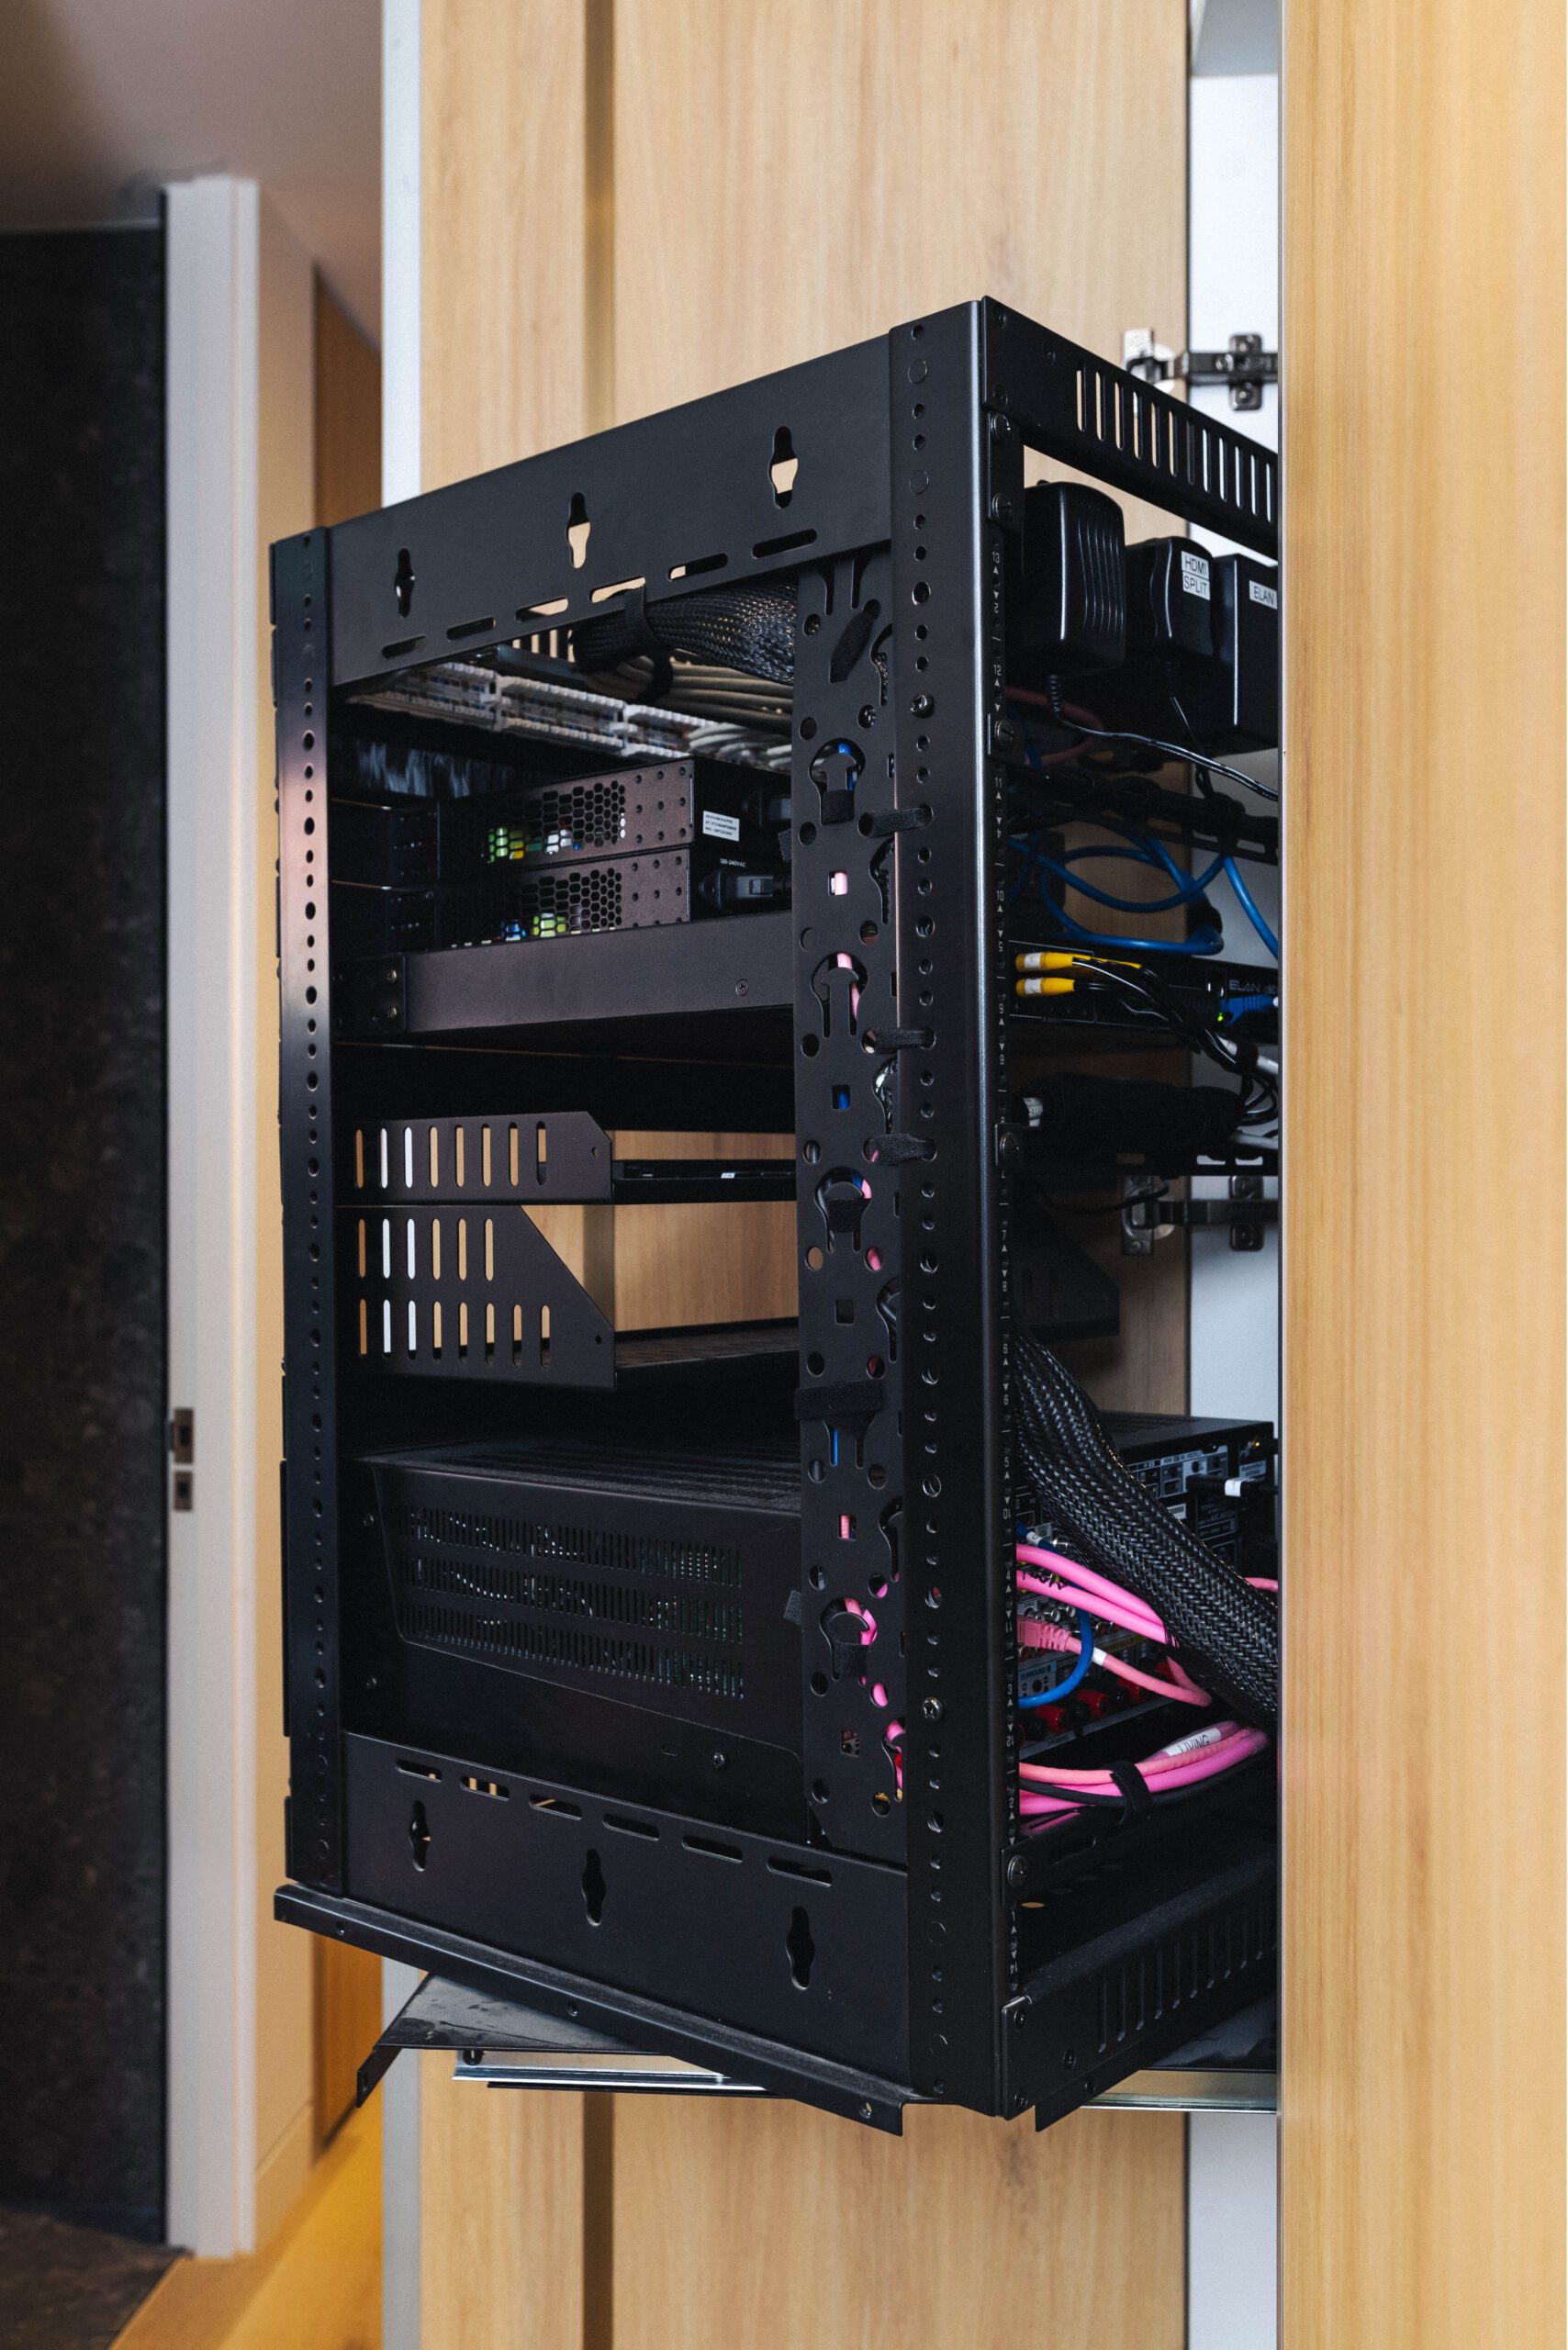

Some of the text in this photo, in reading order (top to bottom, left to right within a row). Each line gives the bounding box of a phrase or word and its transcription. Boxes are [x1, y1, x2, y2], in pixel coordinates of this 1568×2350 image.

[1184, 555, 1206, 576] HDMI
[1183, 576, 1207, 596] SPLIT
[1253, 586, 1274, 605] ELAN
